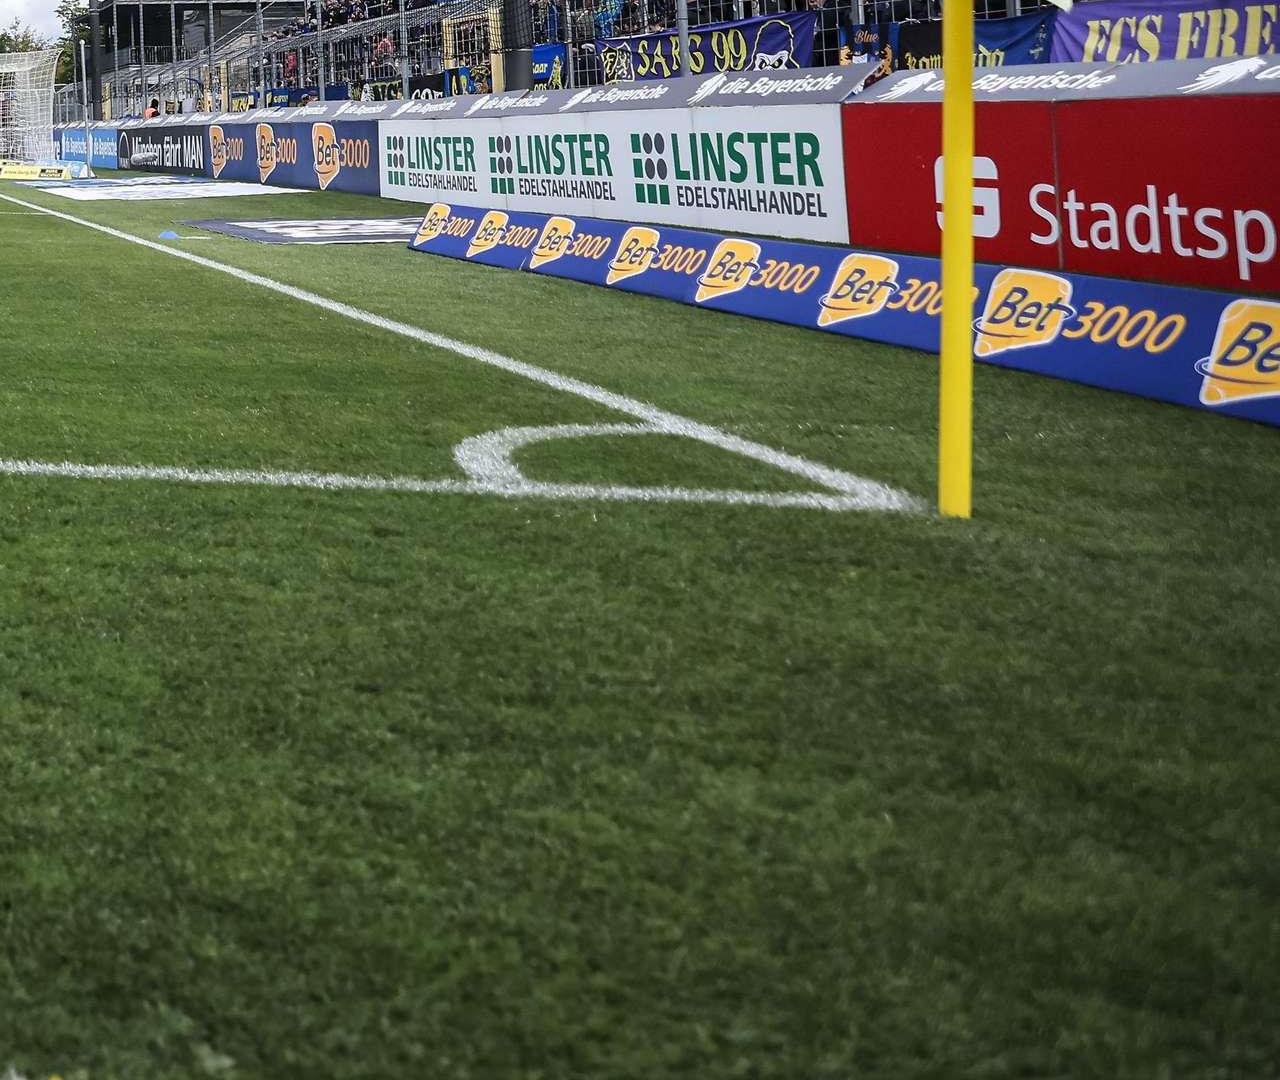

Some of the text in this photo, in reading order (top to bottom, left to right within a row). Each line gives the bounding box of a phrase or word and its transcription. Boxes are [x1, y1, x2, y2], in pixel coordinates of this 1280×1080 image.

[711, 28, 747, 72] 99
[854, 30, 880, 43] Blue
[602, 84, 669, 103] Bayerische
[719, 73, 844, 96] die Bayerische
[164, 135, 182, 167] fährt
[183, 135, 204, 169] MAN
[407, 136, 476, 172] LINSTER
[515, 133, 613, 177] LINSTER
[671, 131, 824, 187] LINSTER
[409, 172, 478, 193] EDELSTAHLHANDEL
[519, 178, 616, 201] EDELSTAHLHANDEL
[677, 185, 828, 218] EDELSTAHLHANDEL
[1028, 183, 1277, 281] Stadtsp
